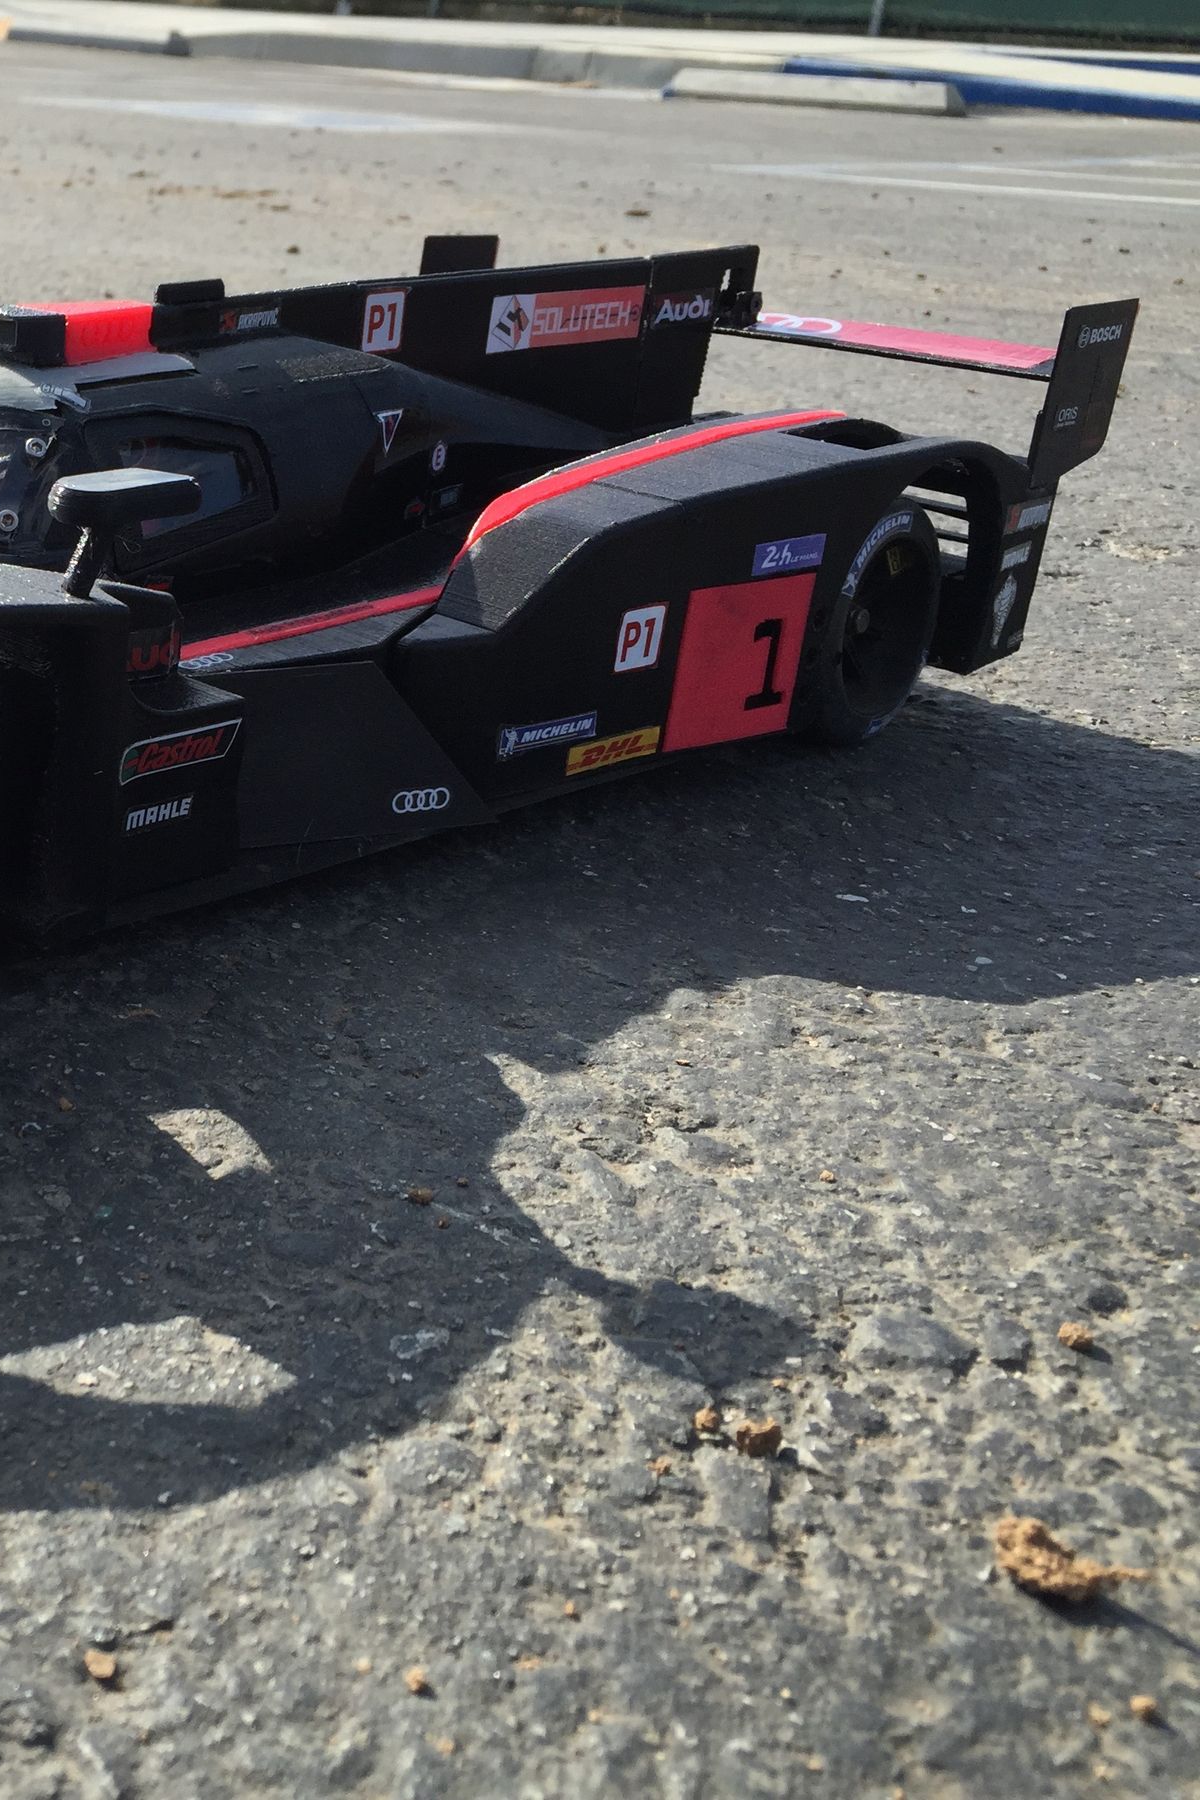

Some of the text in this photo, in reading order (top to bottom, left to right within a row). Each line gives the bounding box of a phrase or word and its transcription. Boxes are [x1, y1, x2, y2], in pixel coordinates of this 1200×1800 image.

[368, 304, 398, 346] P1
[532, 300, 632, 336] SOLUTECH
[654, 294, 711, 325] Audi
[1089, 323, 1123, 344] BOSCH
[855, 513, 911, 568] MICHELIN
[620, 617, 657, 664] P1
[744, 618, 784, 711] 1
[521, 717, 593, 743] MICHELIN
[135, 728, 224, 773] Castrol
[580, 734, 644, 767] DHL
[126, 796, 192, 831] MAHLE
